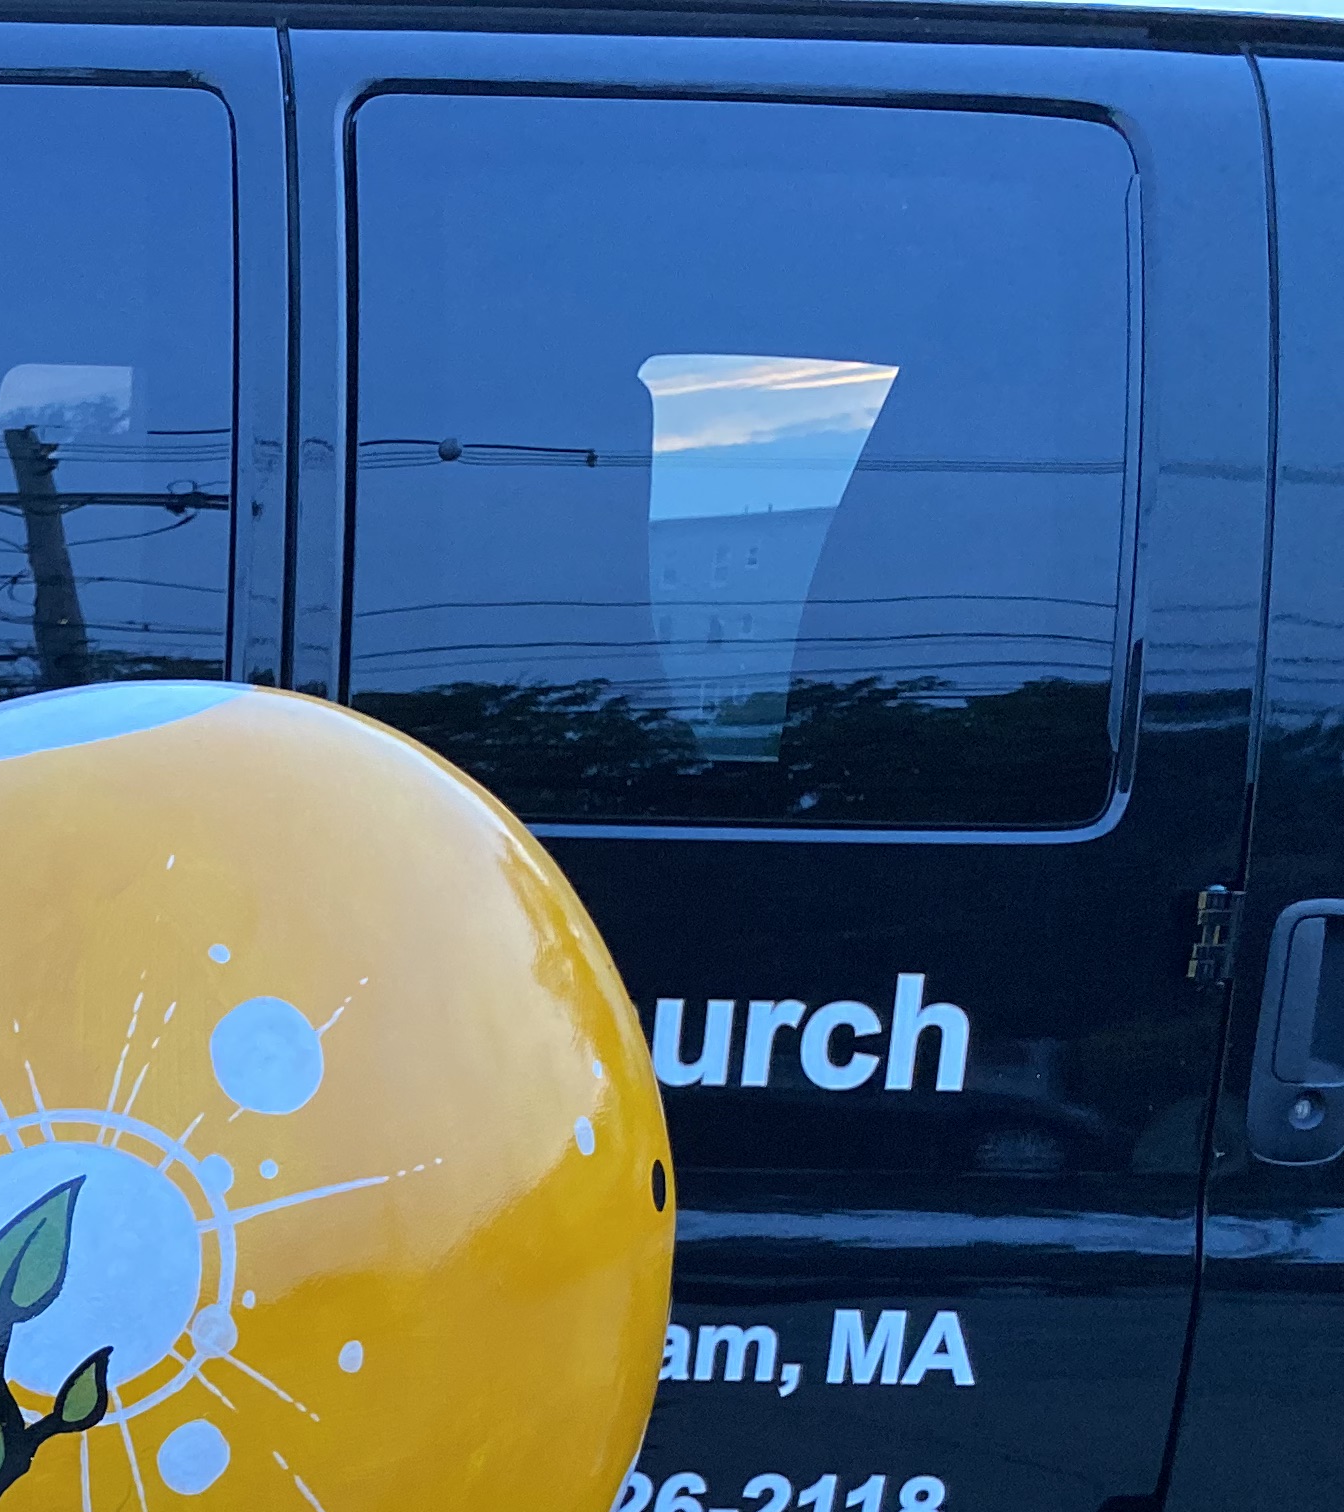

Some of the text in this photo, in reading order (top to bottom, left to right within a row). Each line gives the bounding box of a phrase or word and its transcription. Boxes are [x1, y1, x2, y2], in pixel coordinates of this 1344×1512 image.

[651, 972, 971, 1092] urch
[658, 1308, 976, 1398] am, MA
